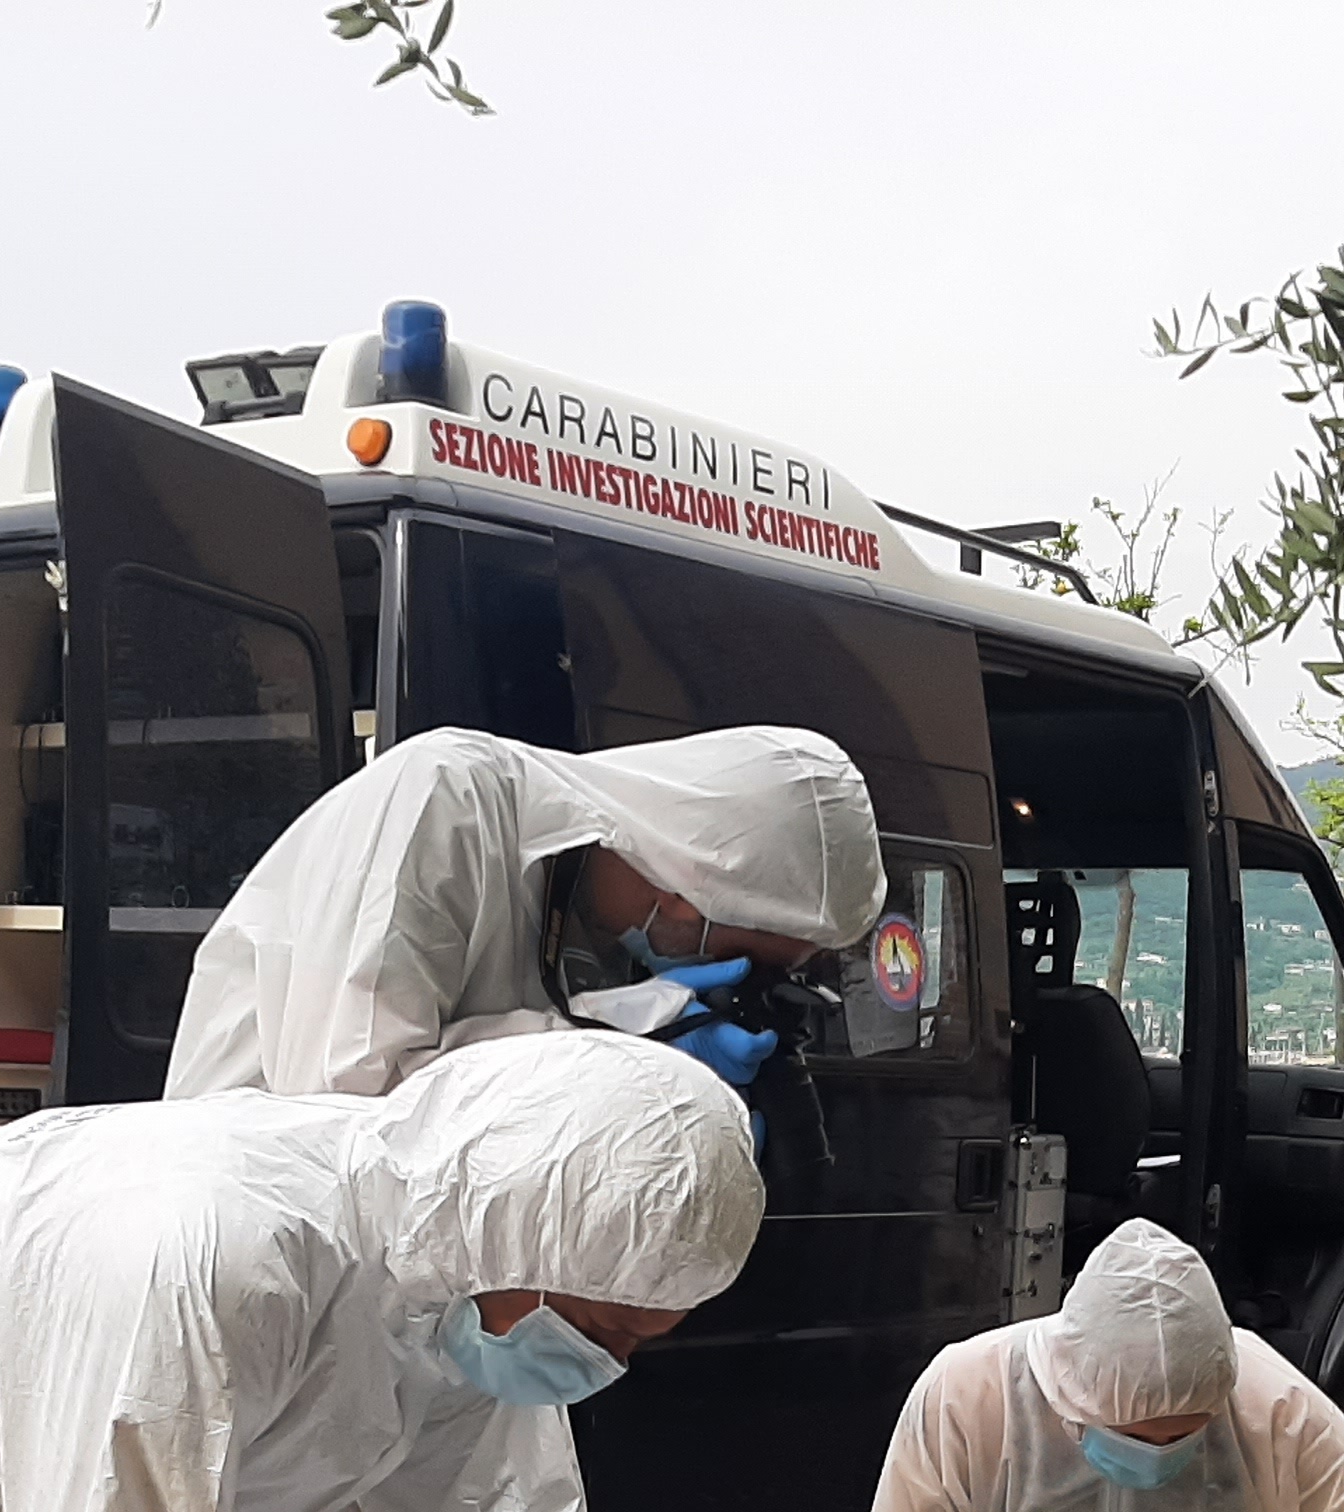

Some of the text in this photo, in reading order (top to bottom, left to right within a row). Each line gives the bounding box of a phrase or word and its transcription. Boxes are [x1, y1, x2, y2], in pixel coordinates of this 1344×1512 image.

[429, 418, 880, 571] SEZIONE INVESTIGAZIONI SCIENTIFICHE
[482, 373, 832, 510] CARABINIERI
